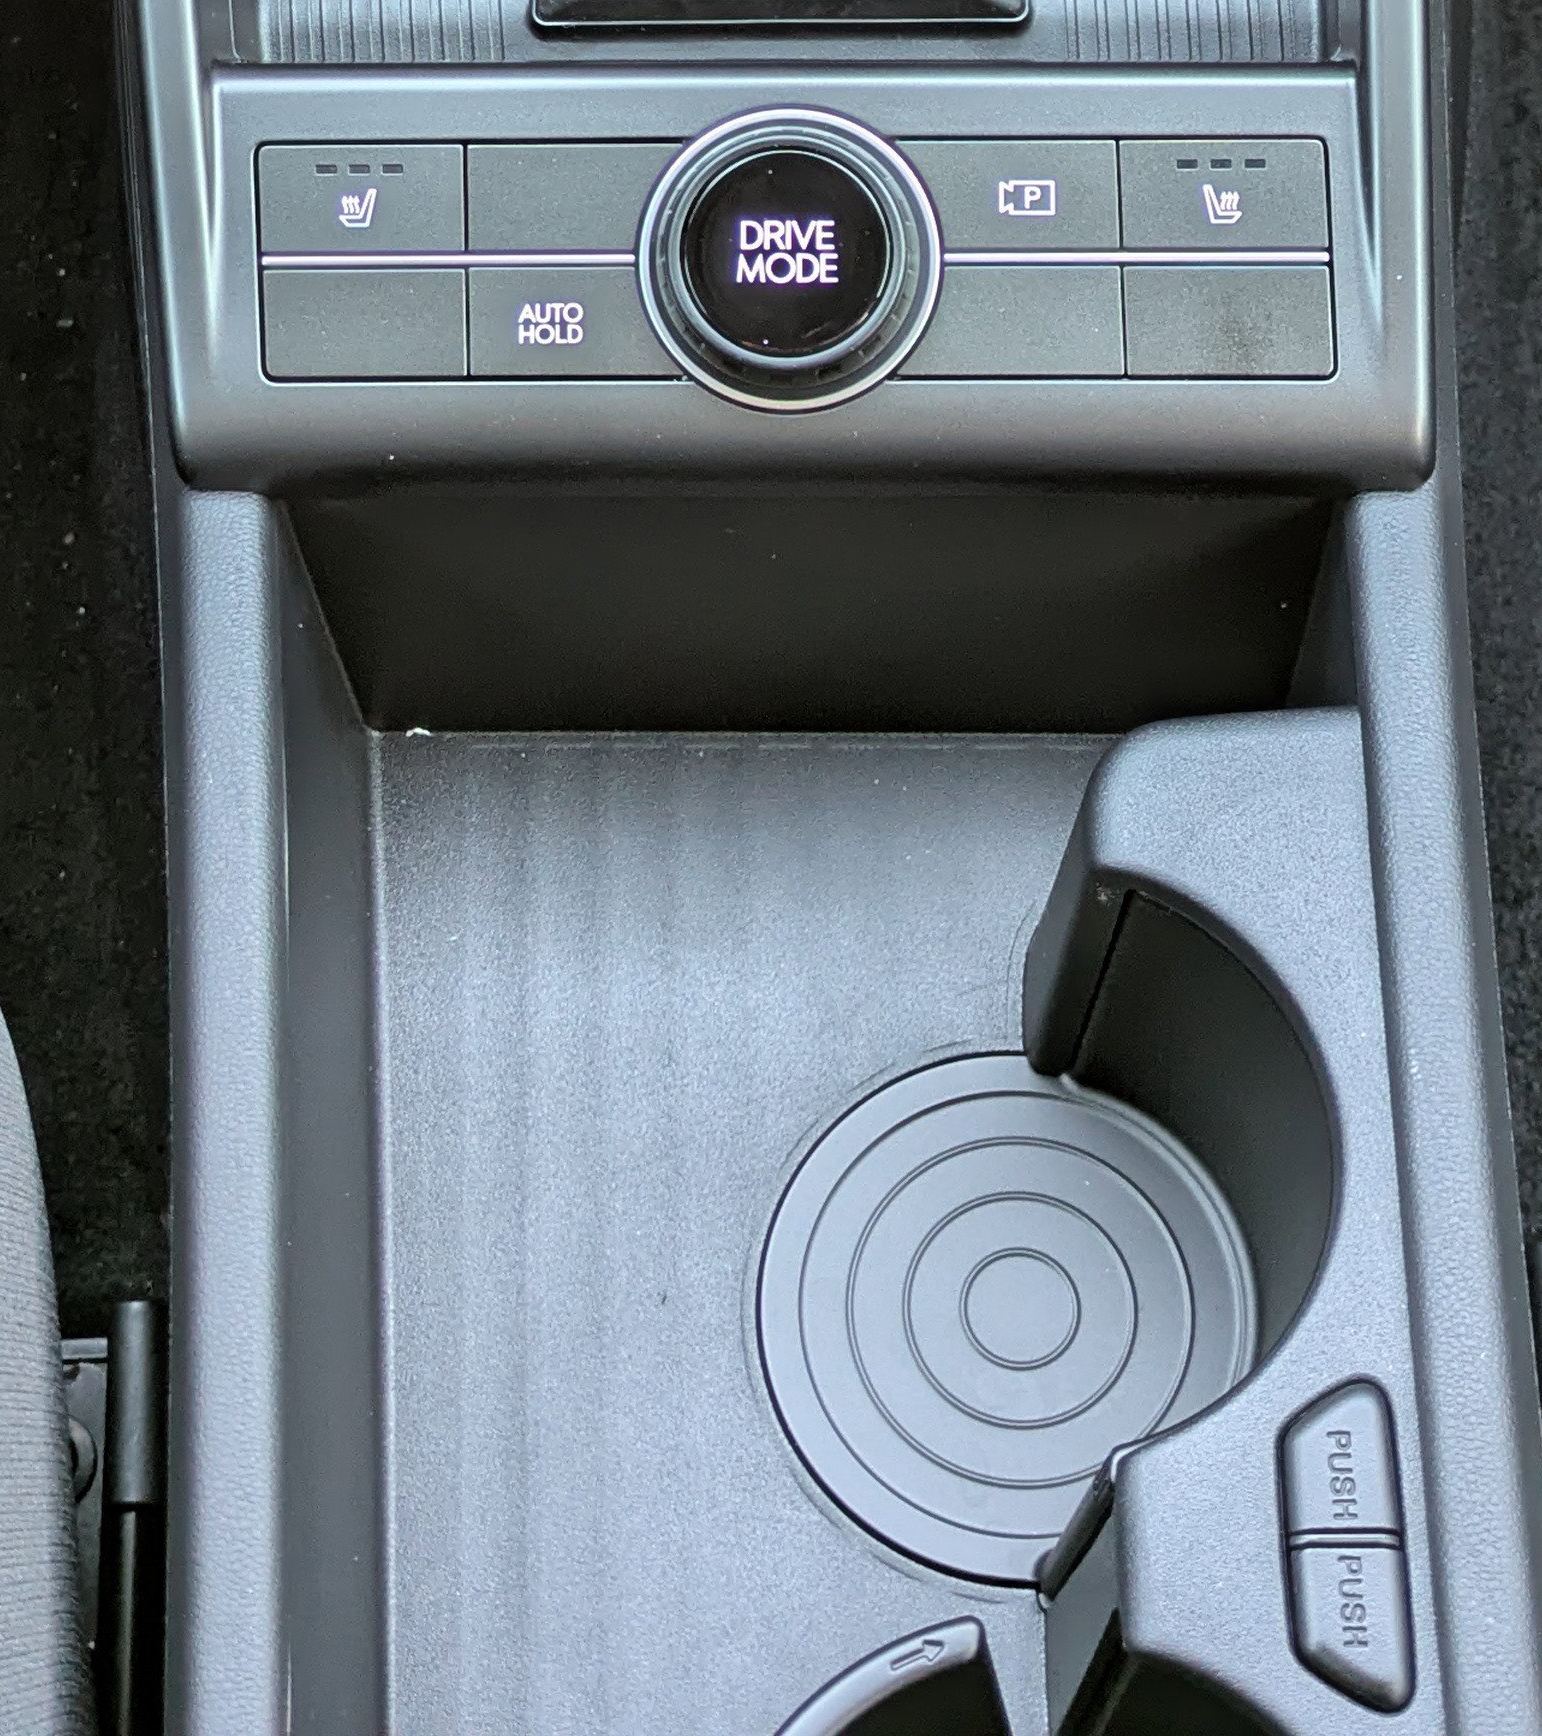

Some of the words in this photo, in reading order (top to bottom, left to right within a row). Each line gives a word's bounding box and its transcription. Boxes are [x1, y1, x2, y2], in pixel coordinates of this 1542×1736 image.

[739, 219, 836, 251] DRIVE
[735, 252, 839, 284] MODE
[518, 302, 584, 324] AUTO
[518, 323, 584, 345] HOLD
[1326, 1429, 1360, 1521] PUSH
[1337, 1554, 1371, 1649] PUSH
